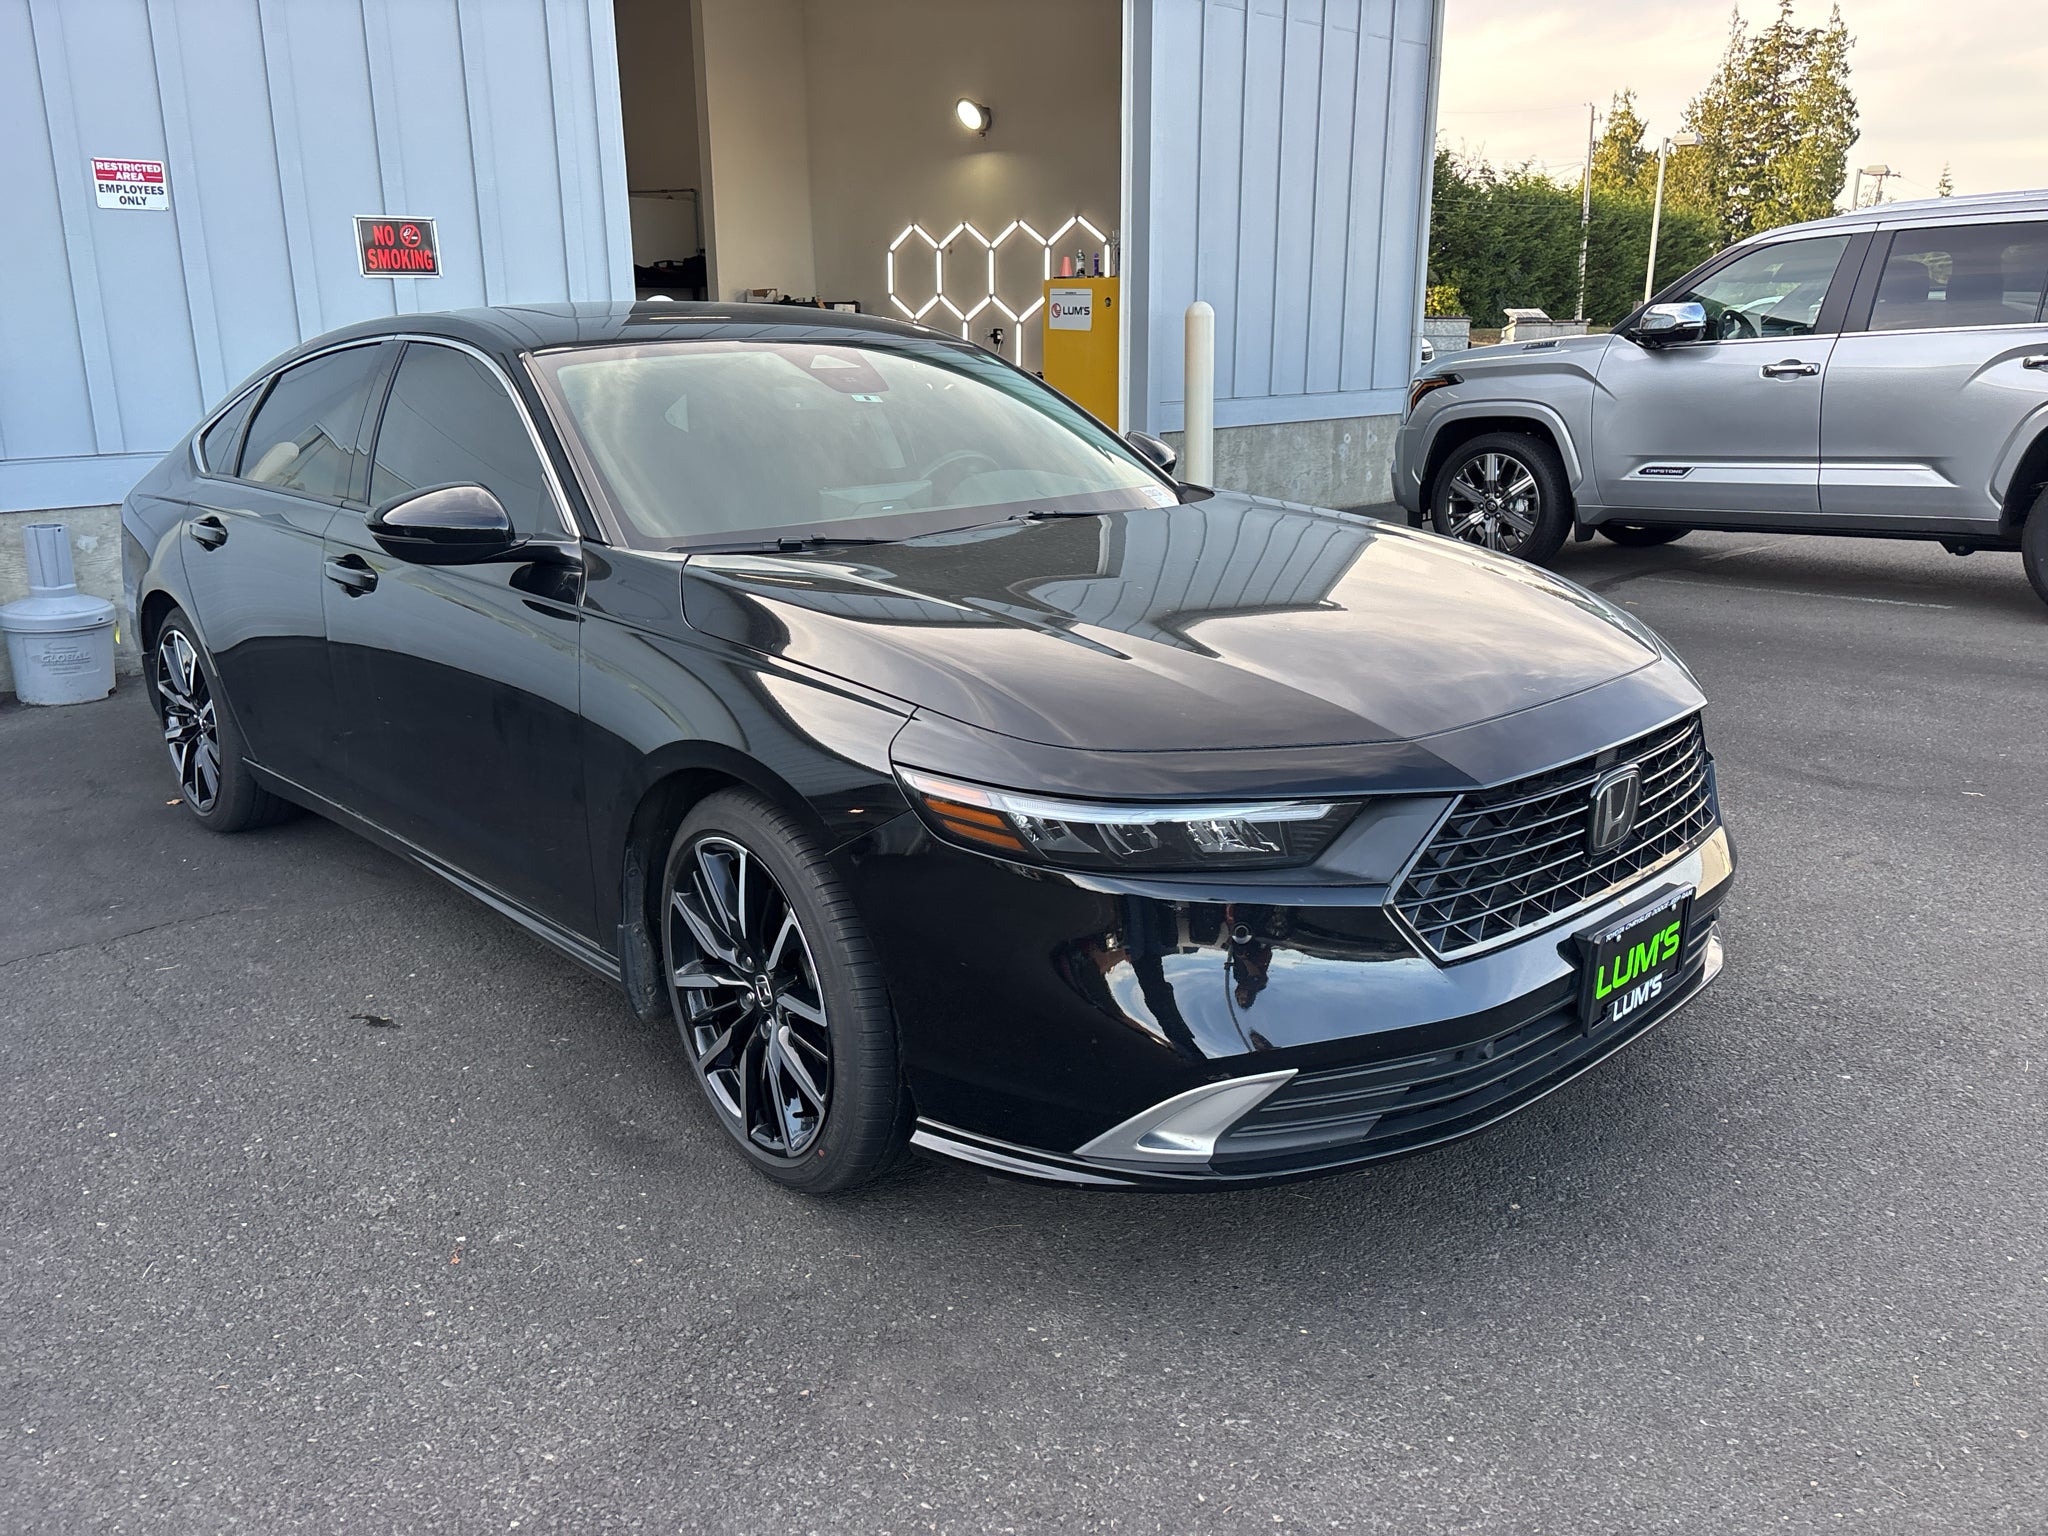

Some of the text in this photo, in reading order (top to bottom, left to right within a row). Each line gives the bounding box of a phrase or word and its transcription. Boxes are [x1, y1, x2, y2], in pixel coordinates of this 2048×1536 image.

[95, 161, 161, 173] RESTRICTED
[115, 172, 145, 181] AREA
[98, 183, 164, 195] EMPLOYEES
[119, 196, 147, 206] ONLY
[373, 225, 395, 246] NO
[367, 248, 433, 270] SMOKING
[1062, 306, 1090, 316] LUM'S
[41, 651, 90, 662] GLOBAL
[1596, 920, 1680, 1000] LUM'S
[1612, 972, 1663, 1022] LUM'S
